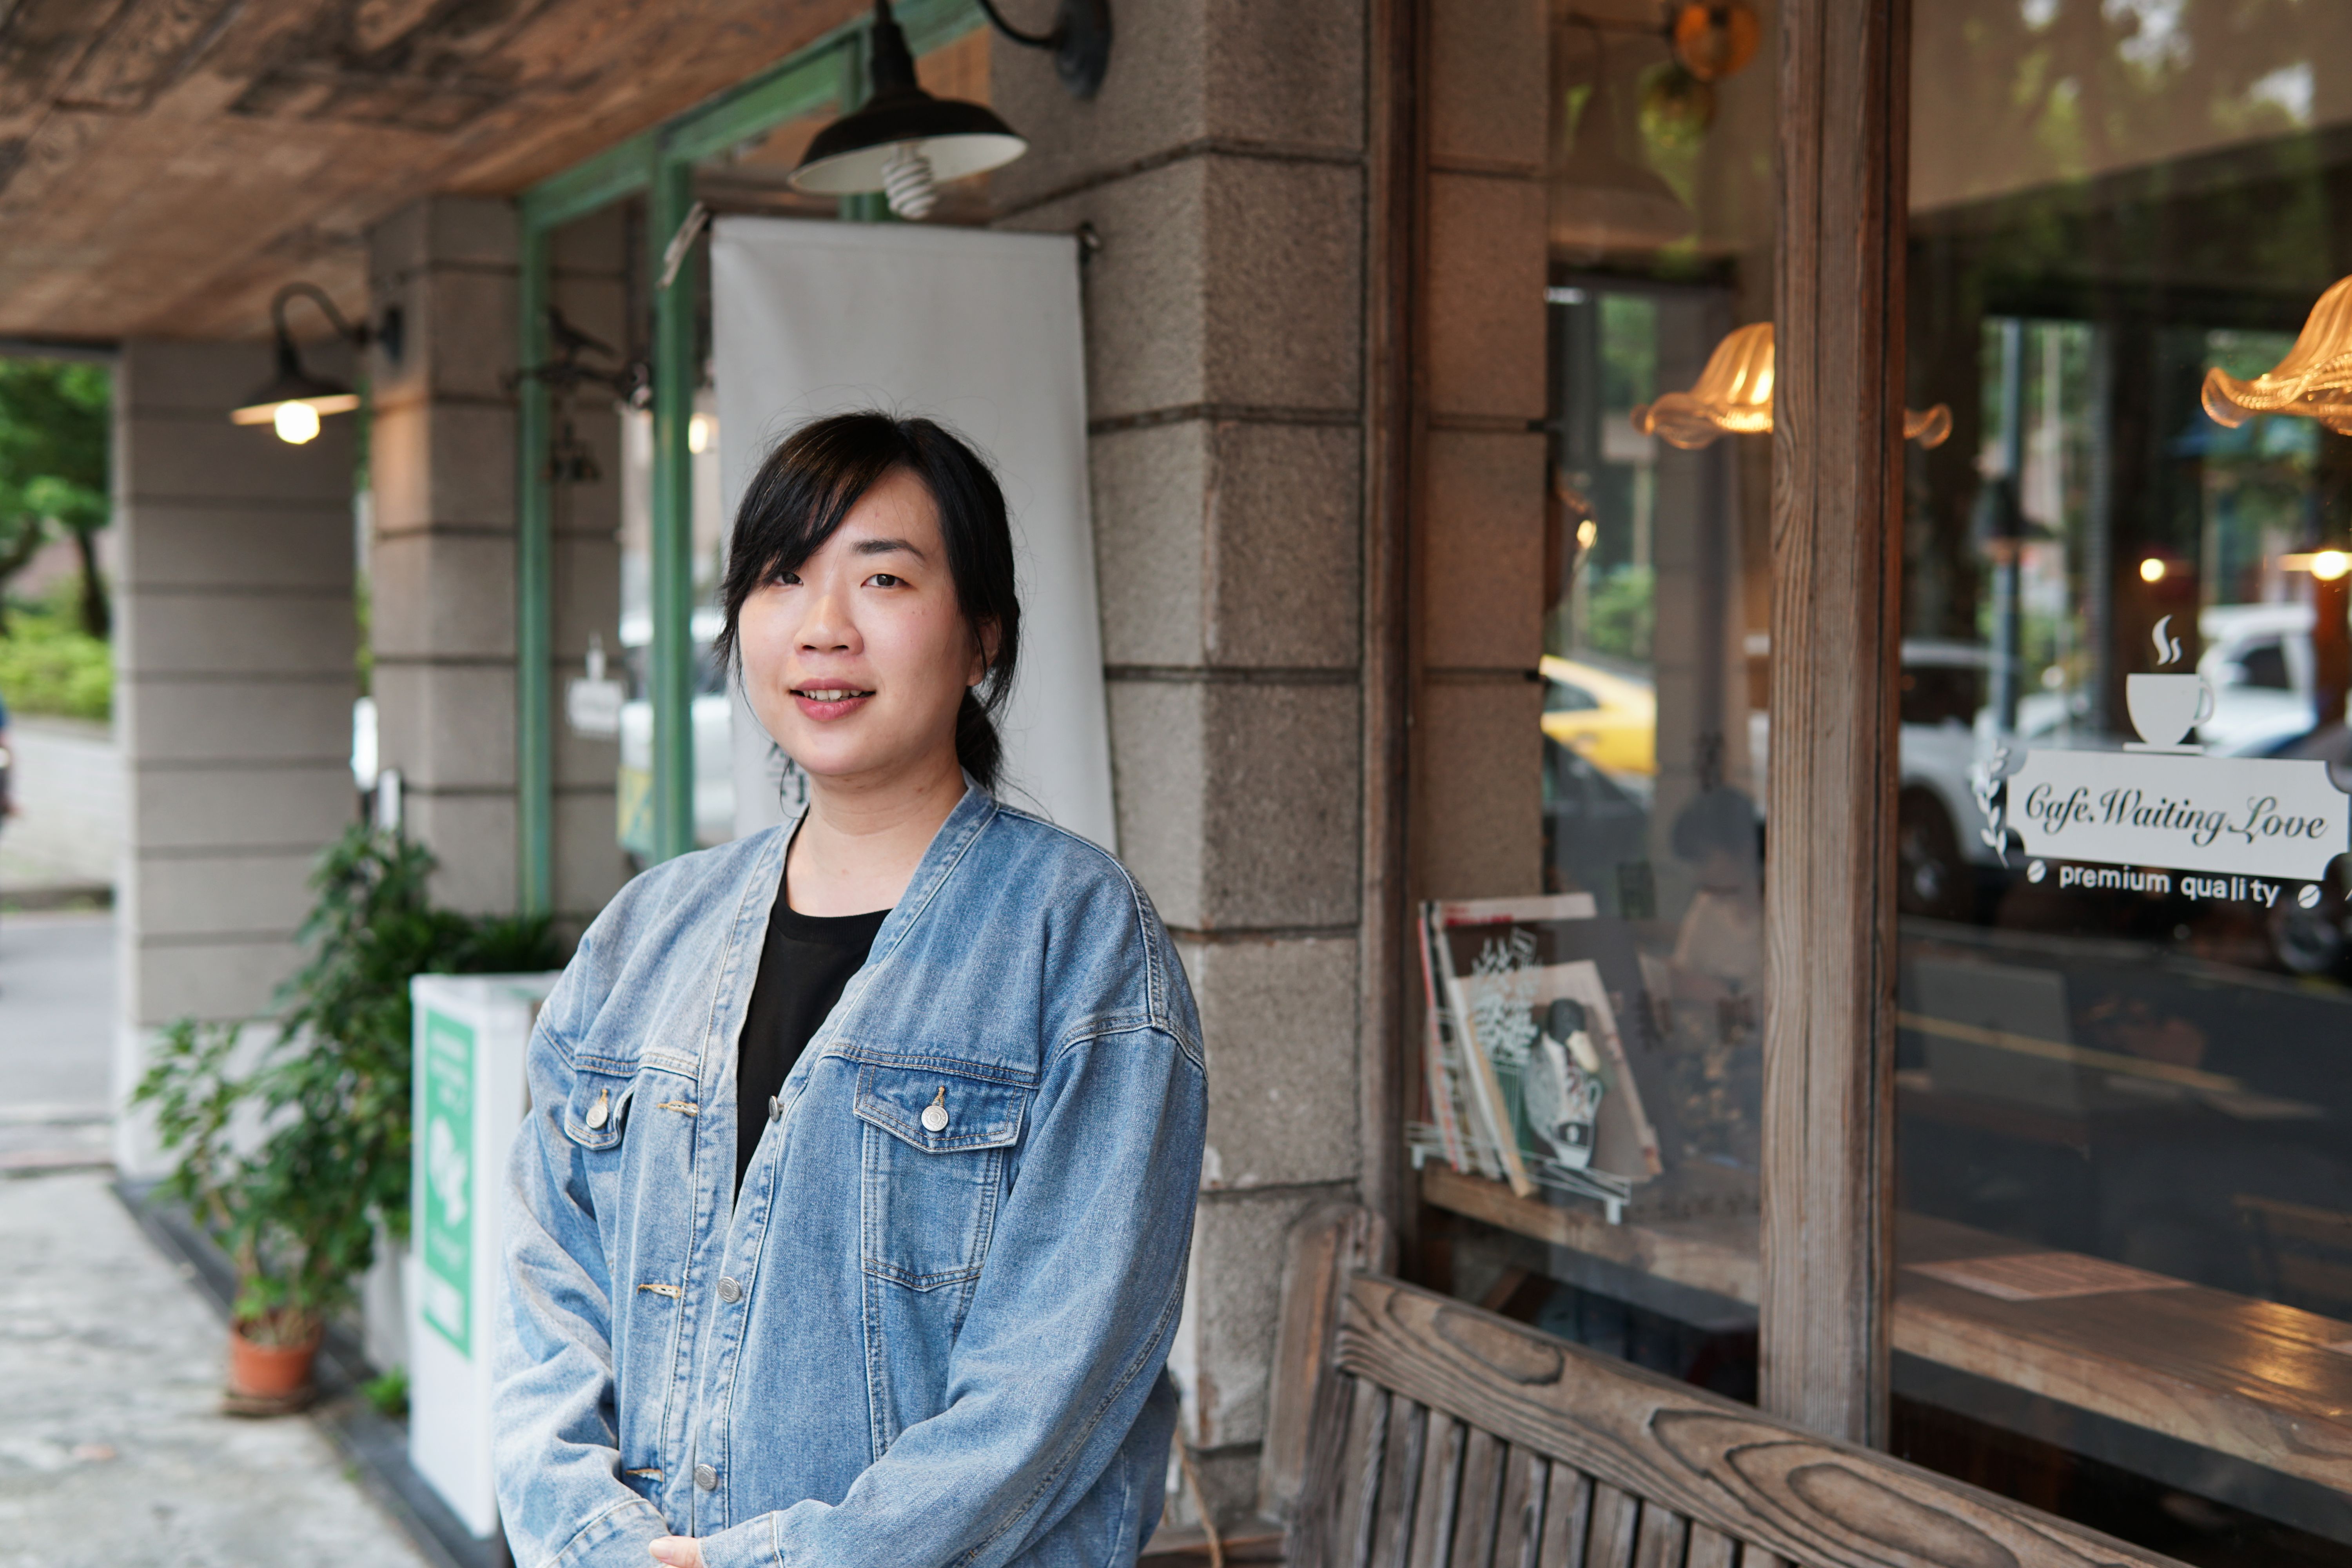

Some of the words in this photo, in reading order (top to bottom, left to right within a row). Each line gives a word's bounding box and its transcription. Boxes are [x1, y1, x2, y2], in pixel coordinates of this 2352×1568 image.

[2227, 796, 2329, 844] Love
[2060, 865, 2171, 894] premium
[2180, 875, 2281, 908] quality
